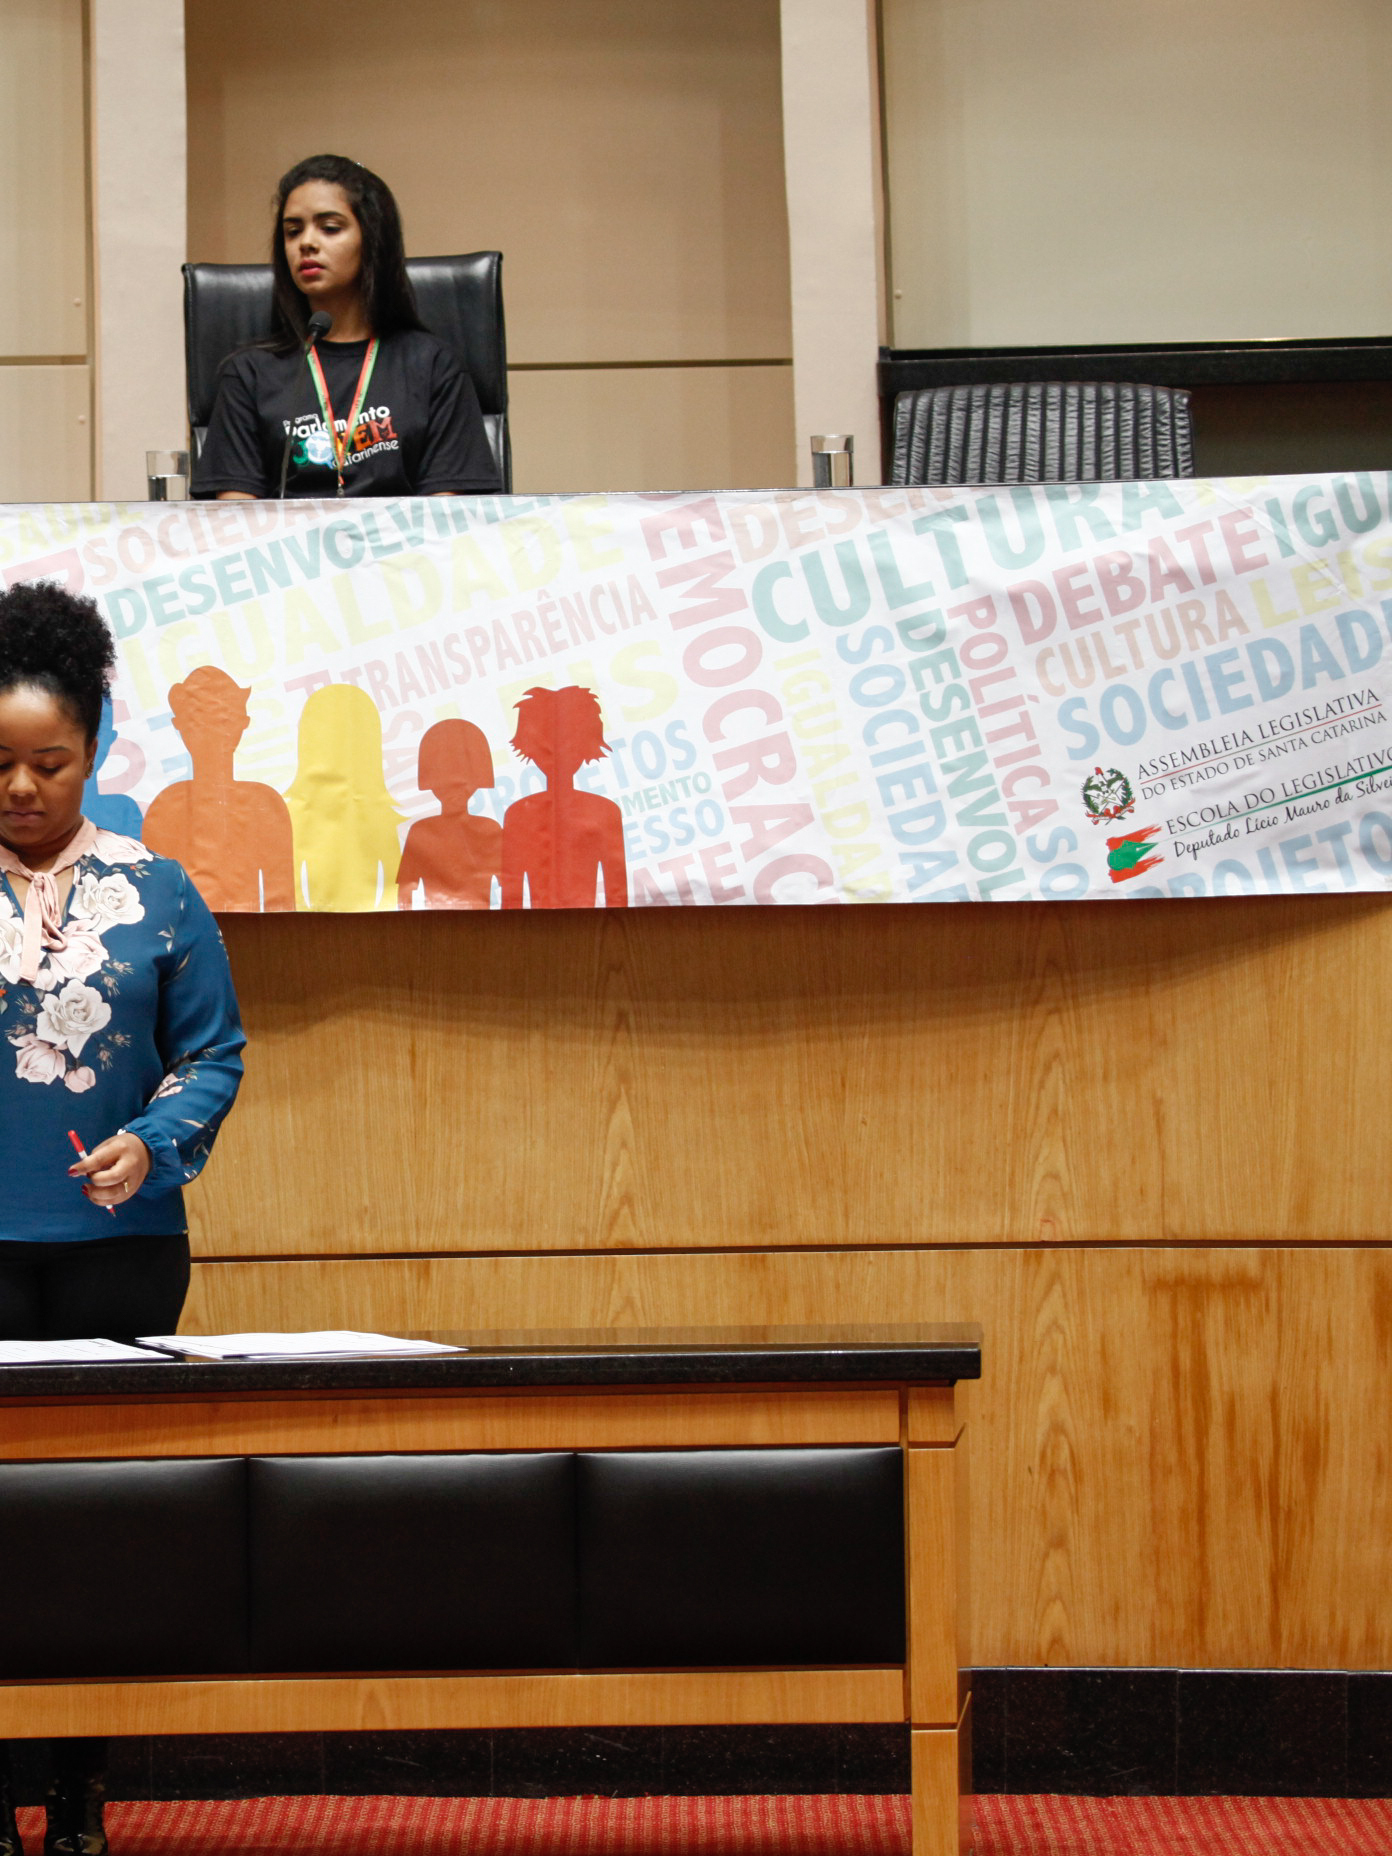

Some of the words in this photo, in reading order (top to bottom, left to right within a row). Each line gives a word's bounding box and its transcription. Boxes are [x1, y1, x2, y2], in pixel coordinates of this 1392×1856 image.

[283, 413, 318, 428] Prgrama
[284, 406, 390, 438] Parlamnto
[751, 478, 1185, 643] CULTURA
[1264, 472, 1392, 559] IGU
[1005, 506, 1270, 646] DEBATE
[1248, 535, 1392, 629] LEIS
[1034, 589, 1251, 698] CULTURA
[947, 594, 1060, 836] POLÍTICA
[1137, 729, 1255, 780] ASSEMBLEIA
[1258, 688, 1380, 739] LEGISLATIVA
[1141, 782, 1167, 801] DO
[1171, 762, 1230, 791] ESTADO
[1233, 755, 1256, 771] DE
[1259, 737, 1308, 763] SANTA
[1310, 711, 1388, 745] CATARINA
[1165, 798, 1240, 836] ESCOLA
[1243, 787, 1275, 809] DO
[1174, 822, 1241, 862] Deputado
[1245, 811, 1280, 835] Lício
[1283, 799, 1331, 824] Mauro
[1335, 787, 1354, 804] da
